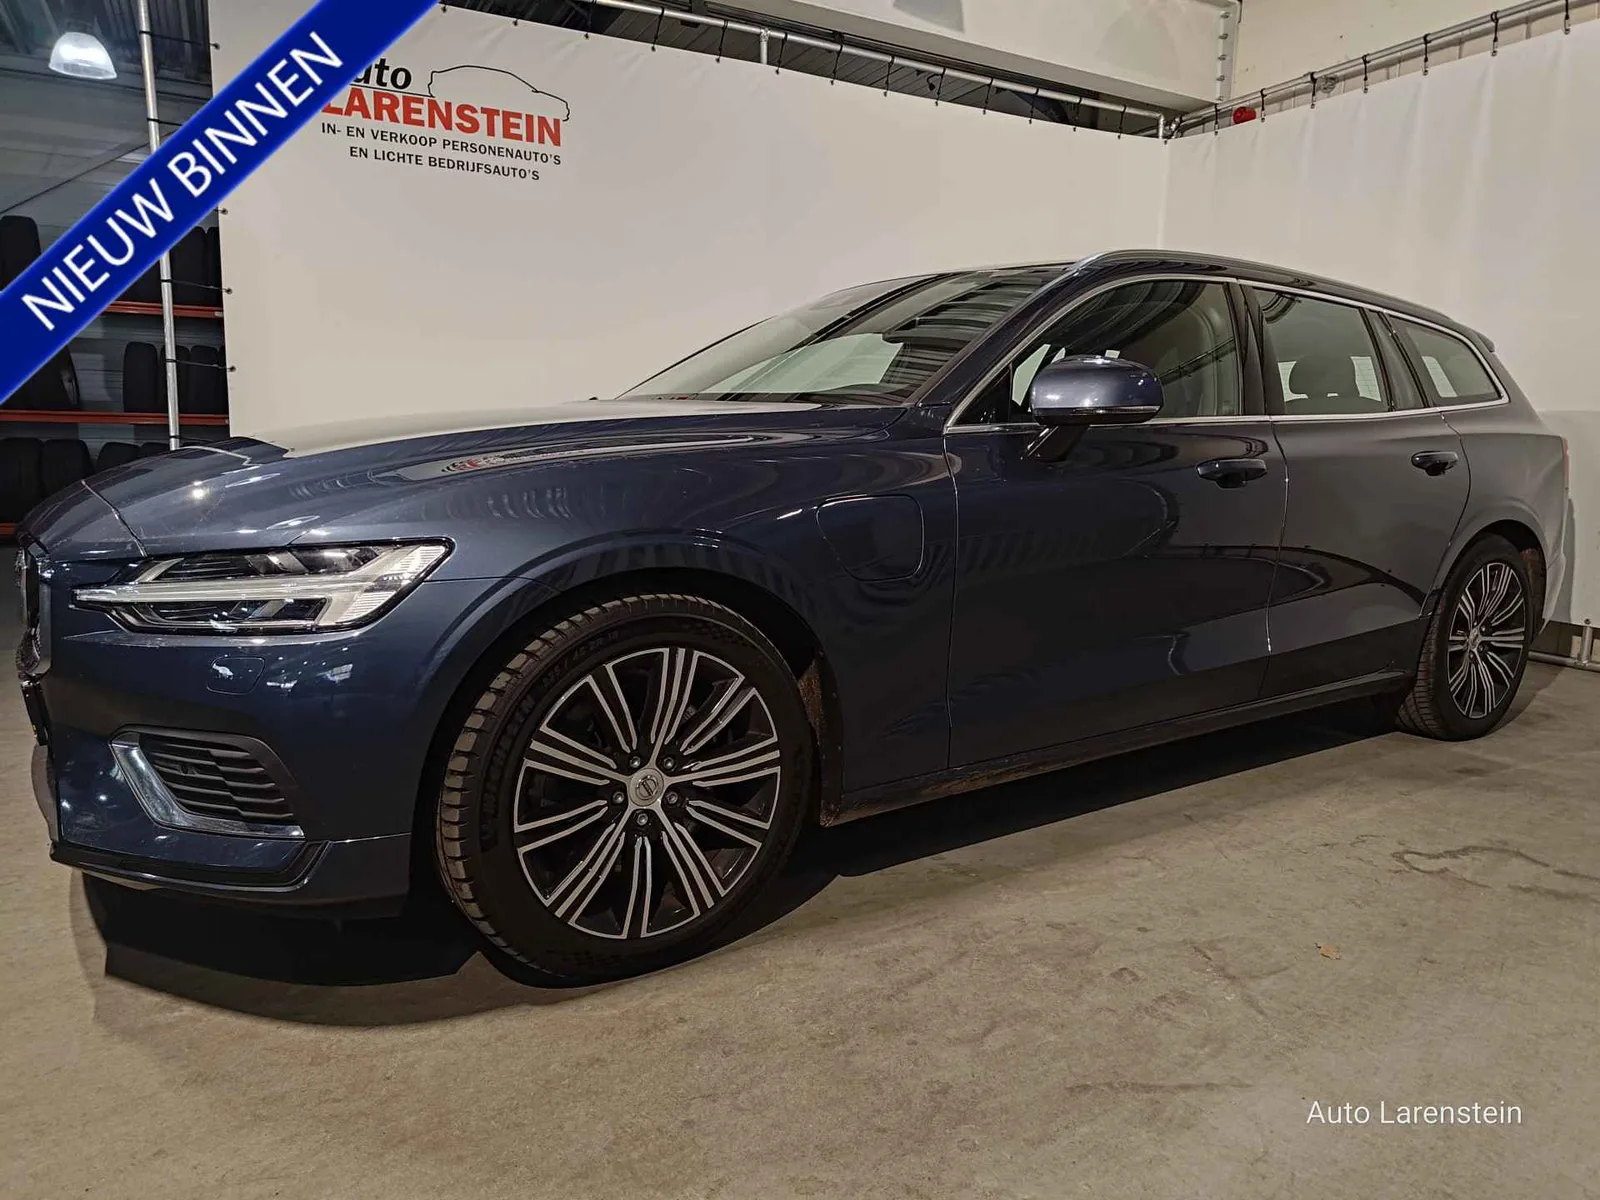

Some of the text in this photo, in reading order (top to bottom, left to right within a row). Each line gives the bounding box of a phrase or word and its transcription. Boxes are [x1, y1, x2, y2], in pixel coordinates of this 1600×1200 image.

[355, 57, 412, 90] uto
[321, 122, 561, 165] IN- EN VERKOOP PERSONENAUTO'S
[349, 146, 540, 181] EN LICHTE BEDRIJFSAUTO'S
